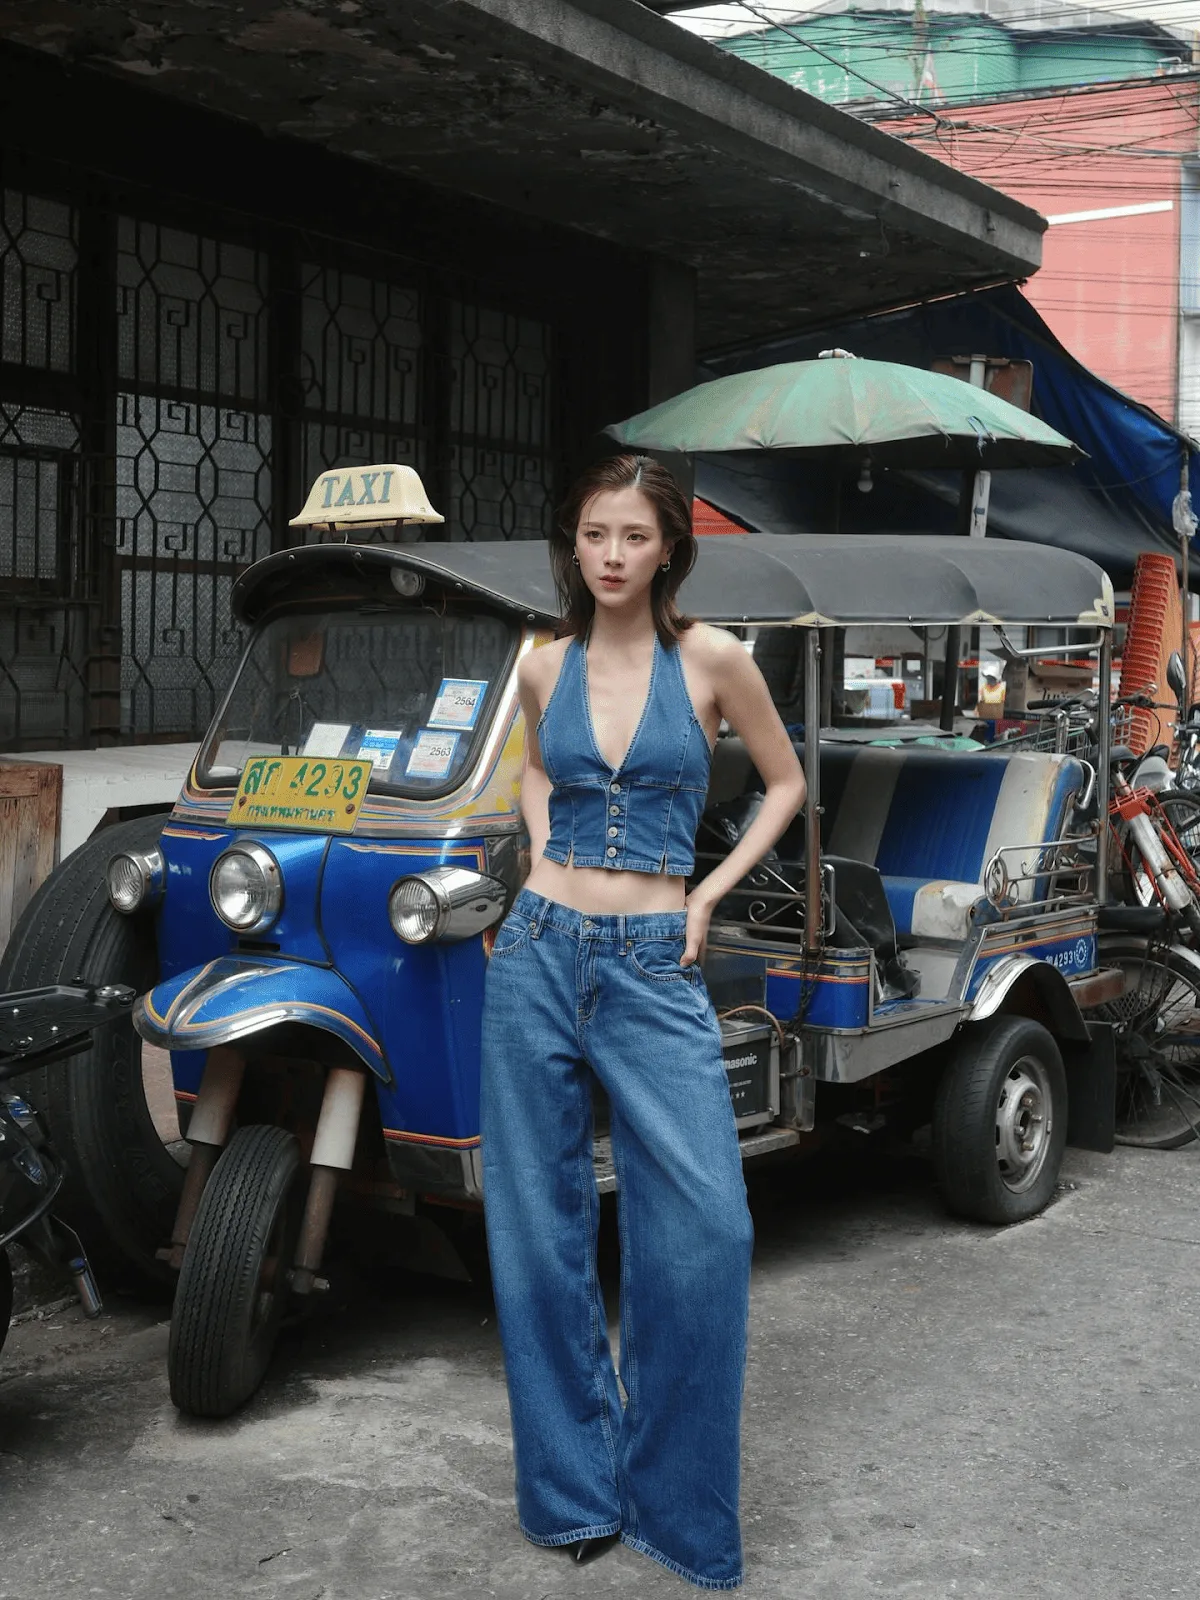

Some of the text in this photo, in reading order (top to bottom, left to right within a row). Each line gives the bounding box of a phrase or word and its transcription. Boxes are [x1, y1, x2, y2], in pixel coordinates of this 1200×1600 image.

[321, 471, 394, 508] TAXI
[454, 696, 476, 706] 2564
[430, 747, 452, 757] 2563
[289, 762, 363, 800] 4293
[725, 1053, 757, 1069] nasonic
